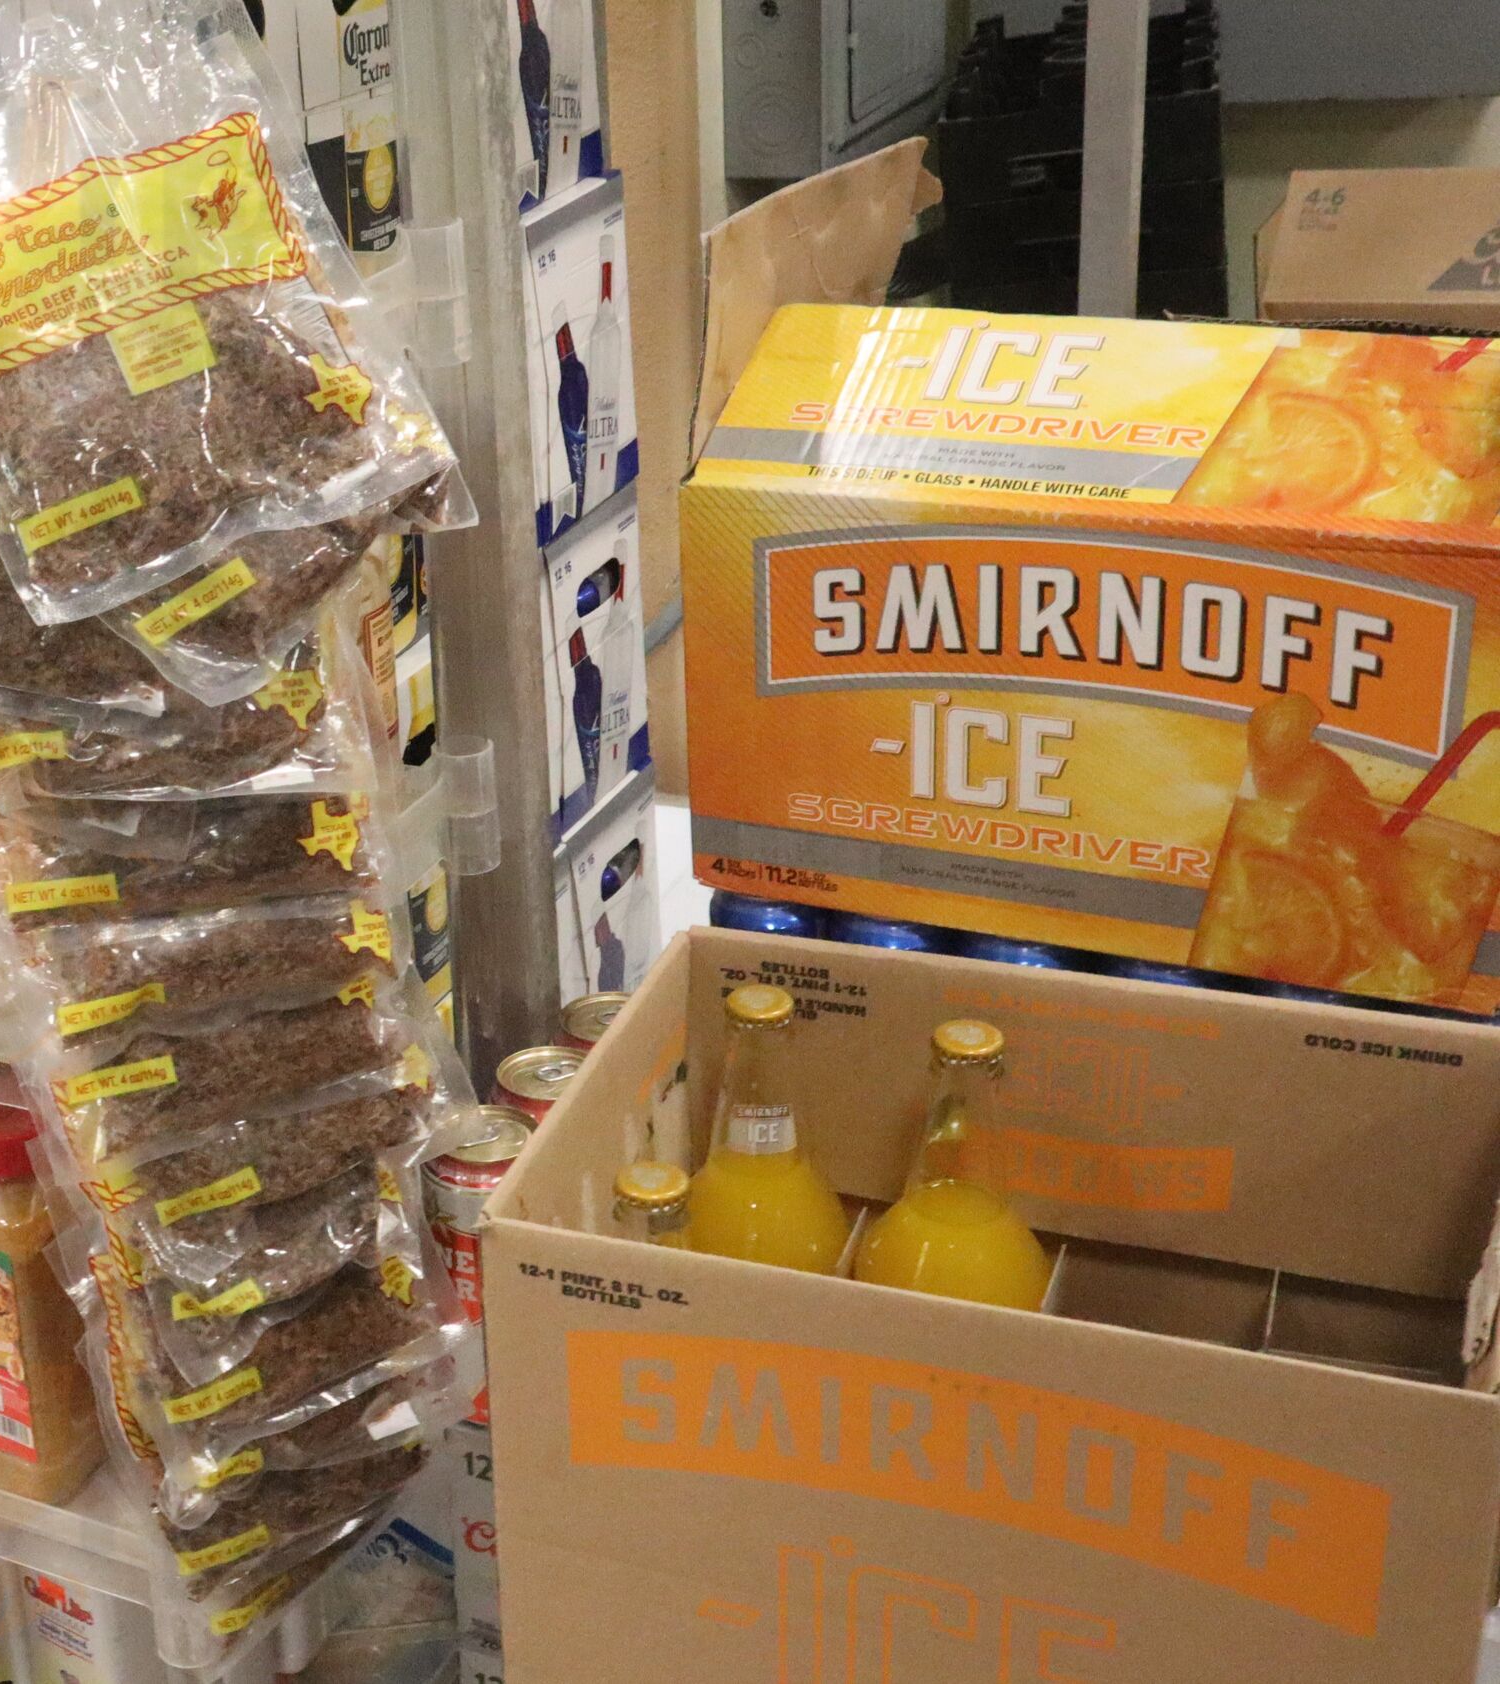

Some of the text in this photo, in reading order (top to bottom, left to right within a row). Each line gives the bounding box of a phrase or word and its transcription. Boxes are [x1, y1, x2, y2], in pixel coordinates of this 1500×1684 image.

[6, 214, 102, 253] taco
[43, 285, 79, 310] BEEF
[789, 402, 1209, 450] SCREWDRIVER
[915, 472, 964, 486] GLASS
[980, 477, 1042, 494] HANDLE
[1045, 481, 1088, 497] WITH
[1089, 484, 1131, 500] CARE
[79, 506, 88, 520] 4
[193, 597, 202, 609] 4
[811, 562, 1394, 710] SMIRNOFF
[787, 792, 1210, 878] SCREWDRIVER
[711, 858, 725, 874] 4
[765, 864, 797, 886] 11.2
[60, 887, 67, 898] 4
[761, 960, 830, 980] BOTTLES
[1304, 1033, 1464, 1068] DRINK ICE COLD
[737, 1106, 790, 1119] SMIRNOFF
[747, 1121, 781, 1144] ICE
[519, 1262, 555, 1281] 12-1
[627, 1282, 653, 1299] FL.
[657, 1288, 690, 1306] OZ.
[562, 1284, 642, 1310] BOTTLES
[463, 1451, 494, 1482] 12
[620, 1356, 1311, 1572] SMIRNOFF
